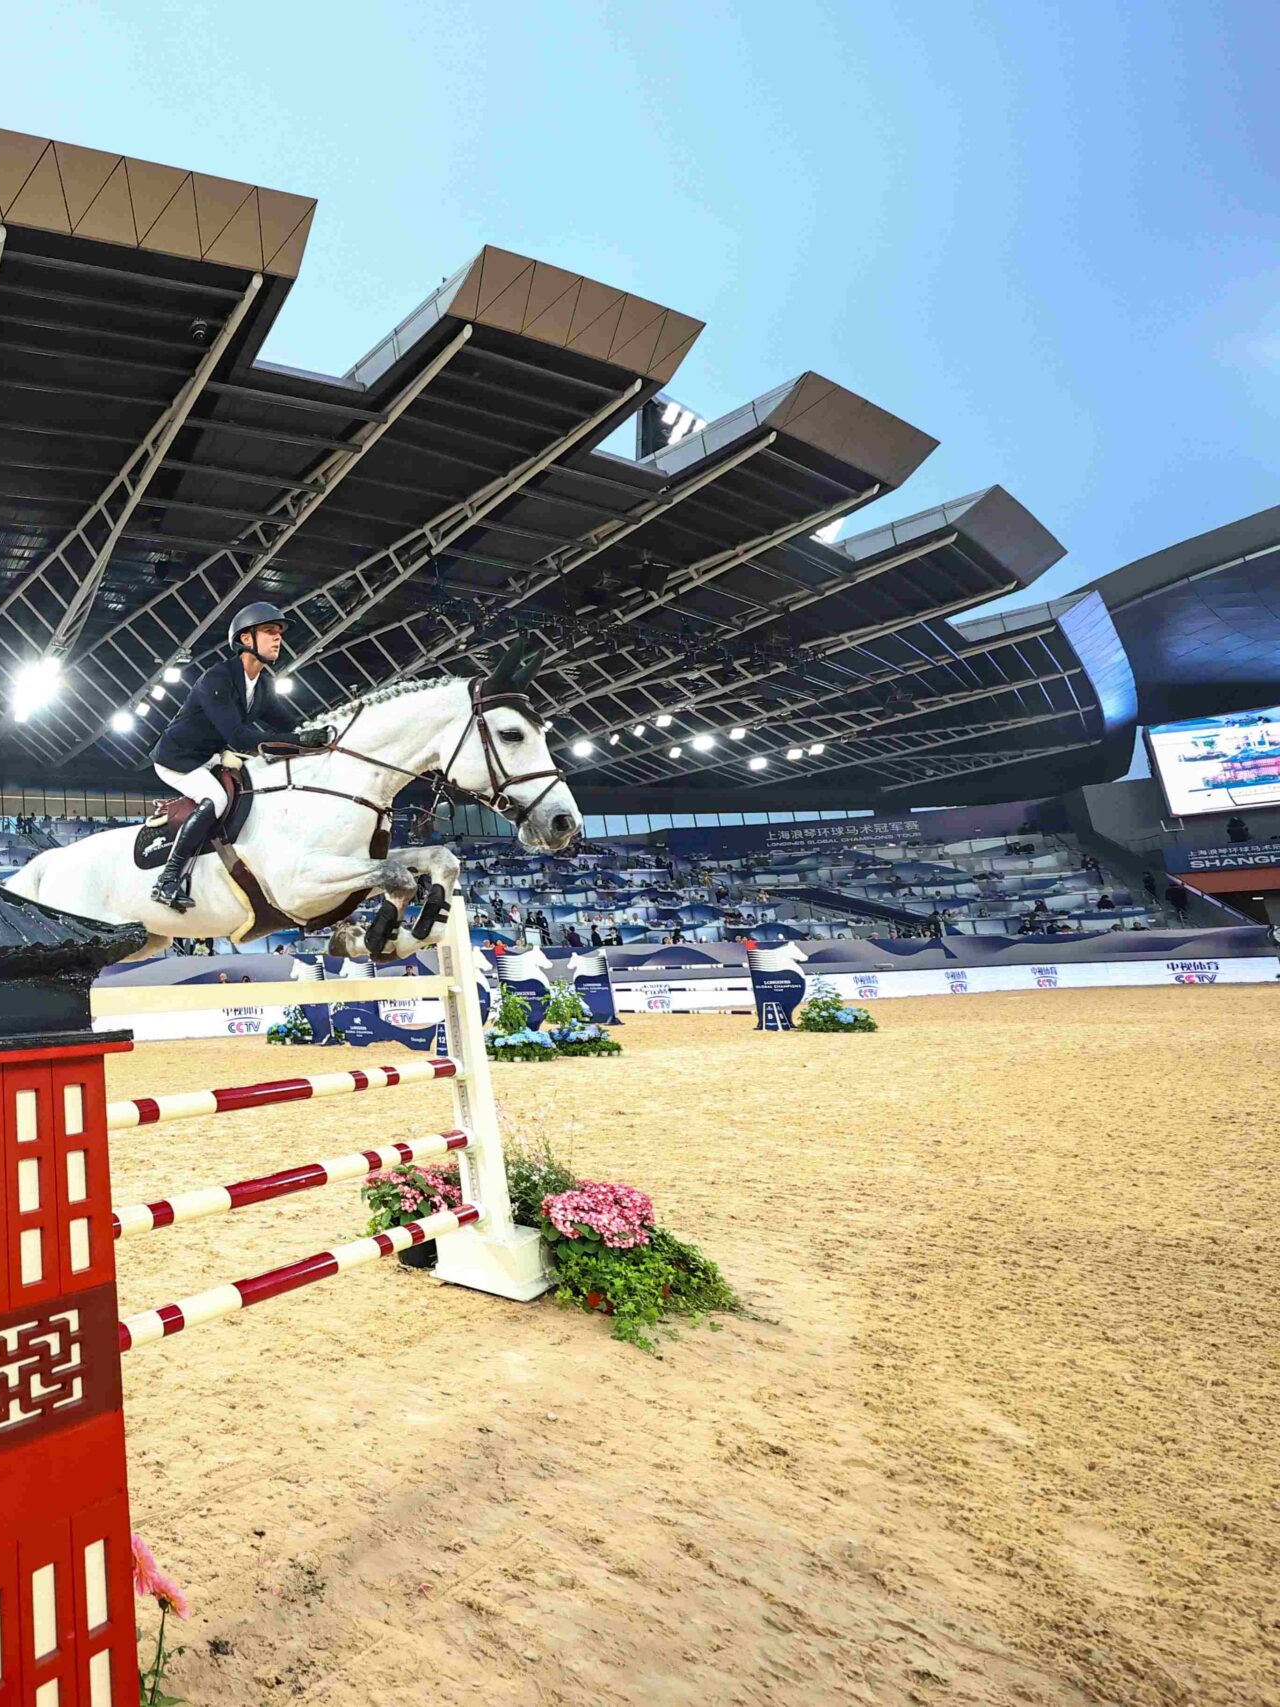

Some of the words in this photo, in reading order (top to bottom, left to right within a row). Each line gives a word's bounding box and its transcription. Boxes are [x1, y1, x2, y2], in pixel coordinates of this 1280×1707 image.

[766, 820, 920, 841] 上海浪琴环球马术冠军赛
[841, 834, 894, 843] CHAMPIONS
[1037, 979, 1057, 988] CCTV
[1175, 974, 1217, 984] CCTV
[950, 983, 968, 993] CCTV
[859, 989, 878, 998] CCTV
[647, 1000, 671, 1009] CCTV
[384, 1012, 415, 1024] CCTV
[228, 1021, 261, 1033] CCTV
